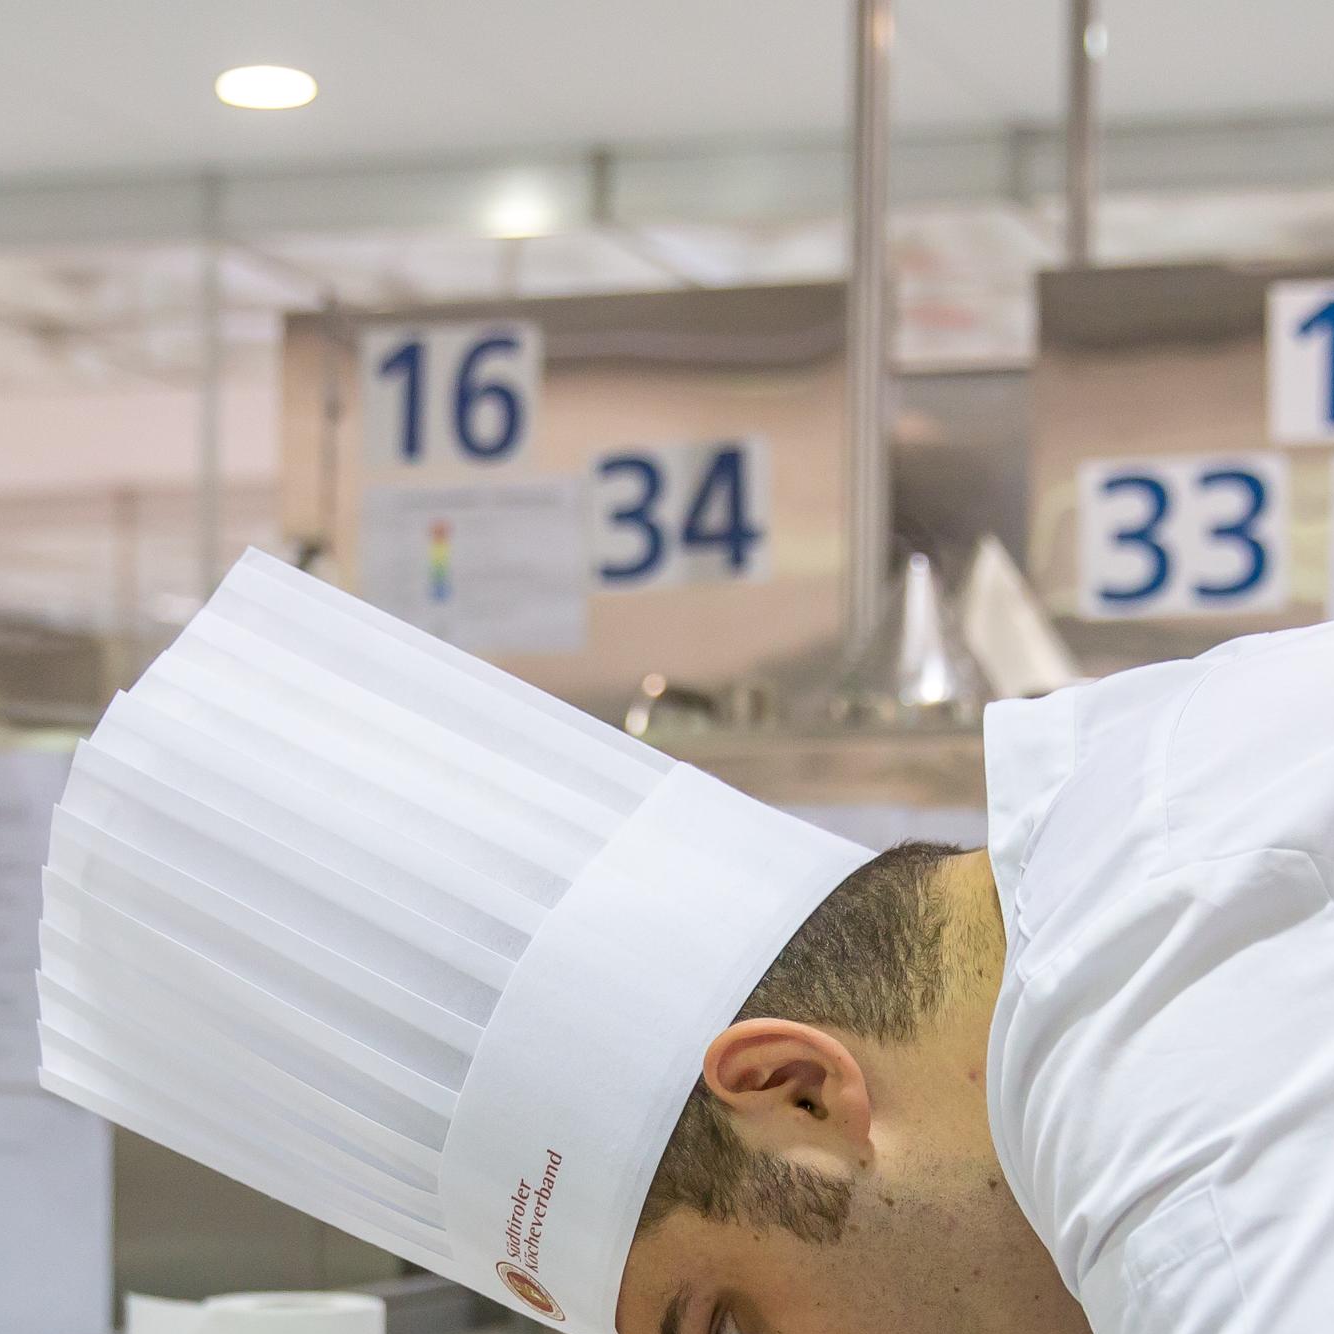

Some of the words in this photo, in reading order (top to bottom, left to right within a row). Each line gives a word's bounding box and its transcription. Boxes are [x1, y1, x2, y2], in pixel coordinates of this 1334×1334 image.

[377, 332, 527, 461] 16
[596, 445, 766, 585] 34
[1097, 466, 1271, 606] 33
[505, 1177, 532, 1263] Südtiroler
[523, 1148, 564, 1275] Köcheverband
